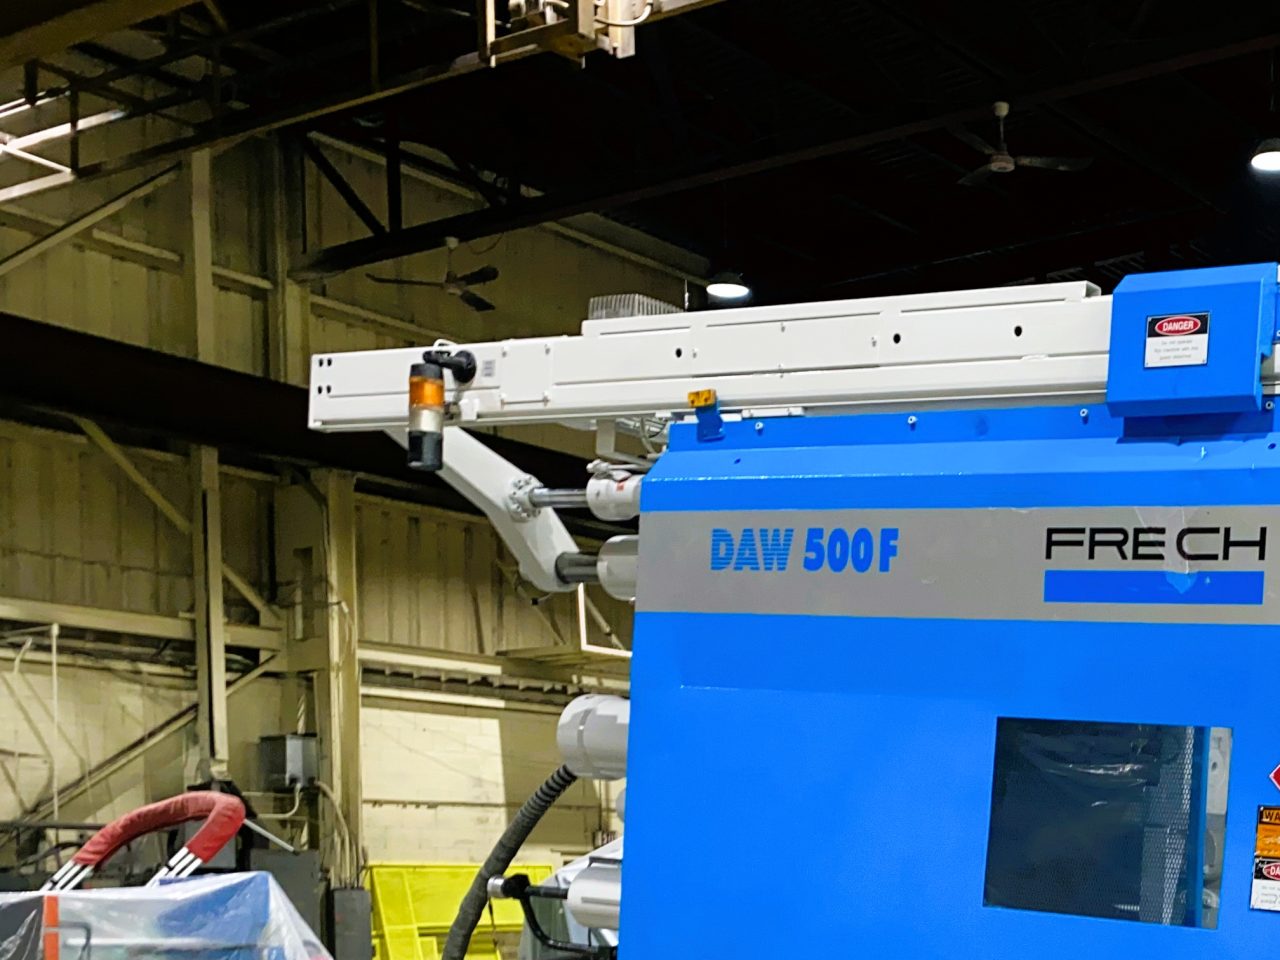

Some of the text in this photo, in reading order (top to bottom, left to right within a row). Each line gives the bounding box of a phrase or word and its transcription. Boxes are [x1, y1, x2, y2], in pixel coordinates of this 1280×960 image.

[1162, 320, 1194, 332] DANGER
[710, 528, 794, 571] DAW
[1044, 526, 1267, 561] FRECH
